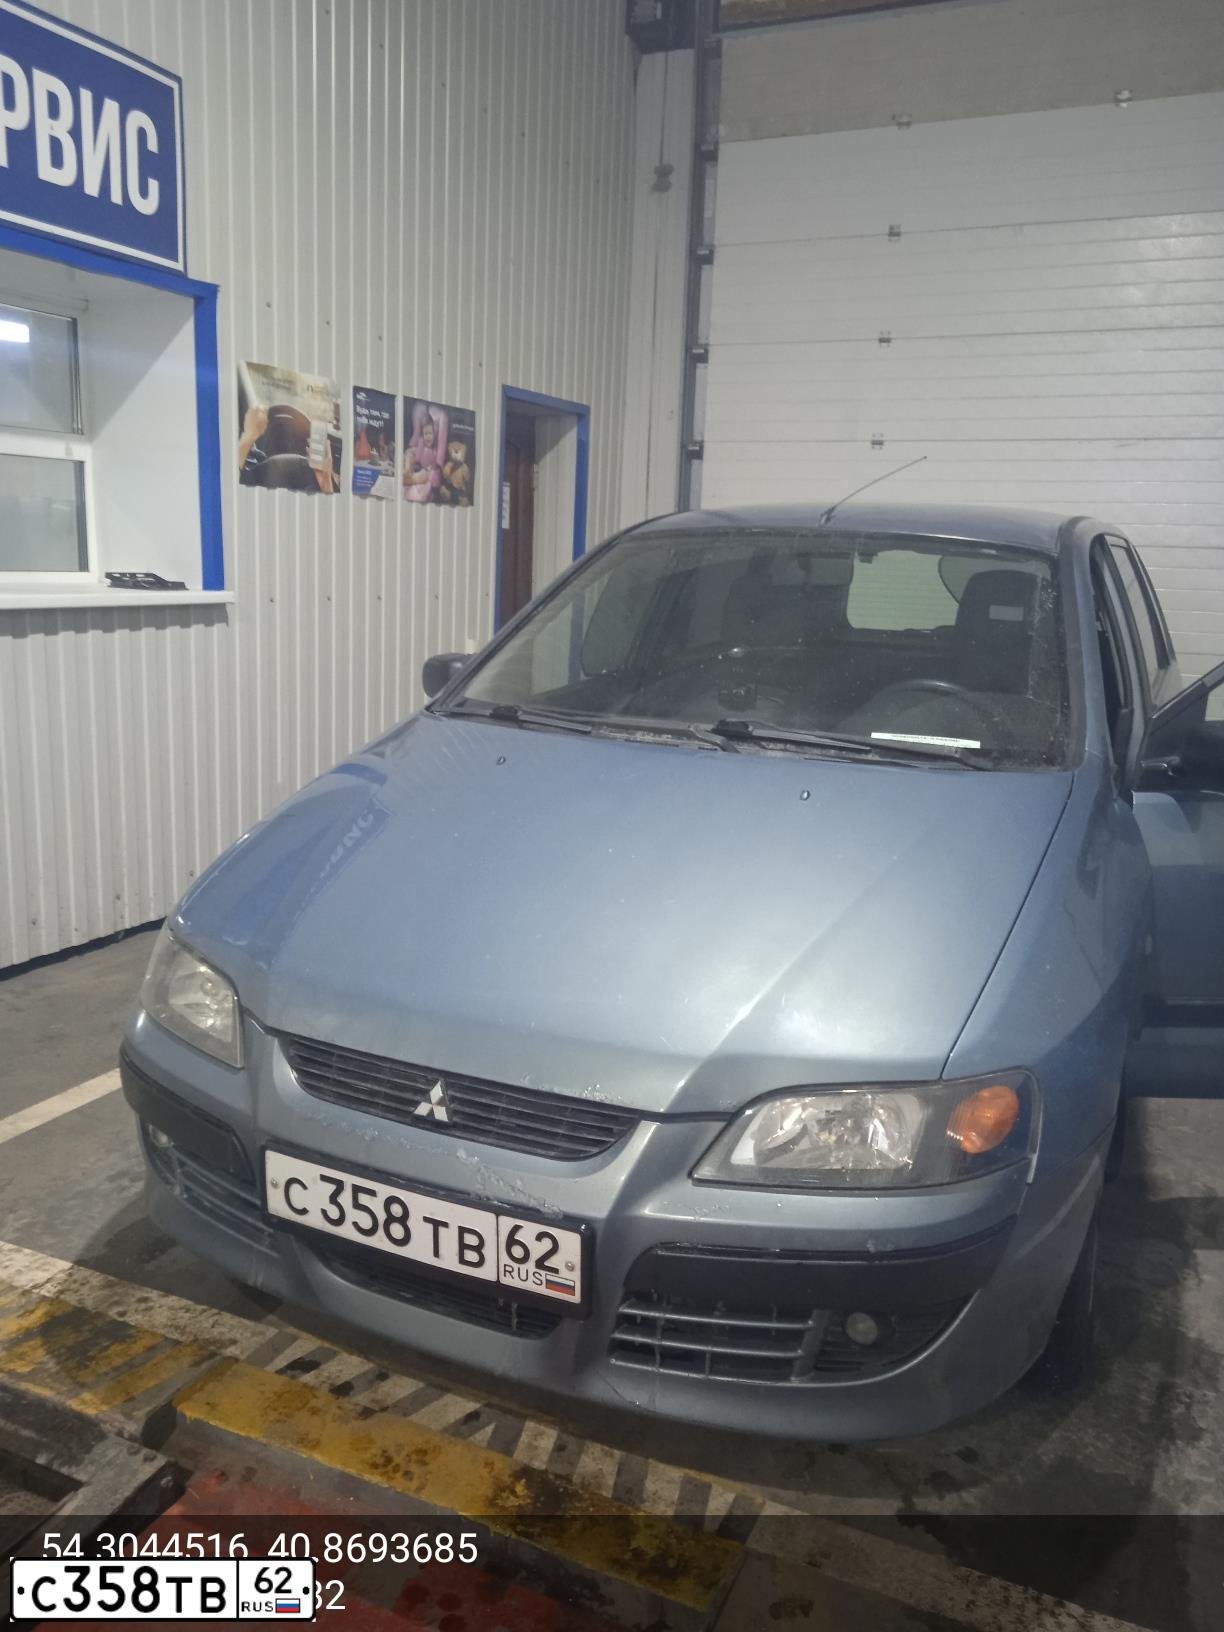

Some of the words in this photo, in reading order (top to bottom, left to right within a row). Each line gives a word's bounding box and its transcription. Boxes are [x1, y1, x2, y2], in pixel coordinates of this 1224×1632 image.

[0, 54, 160, 216] РВИС
[505, 1223, 560, 1275] 62
[503, 1264, 544, 1287] RUS
